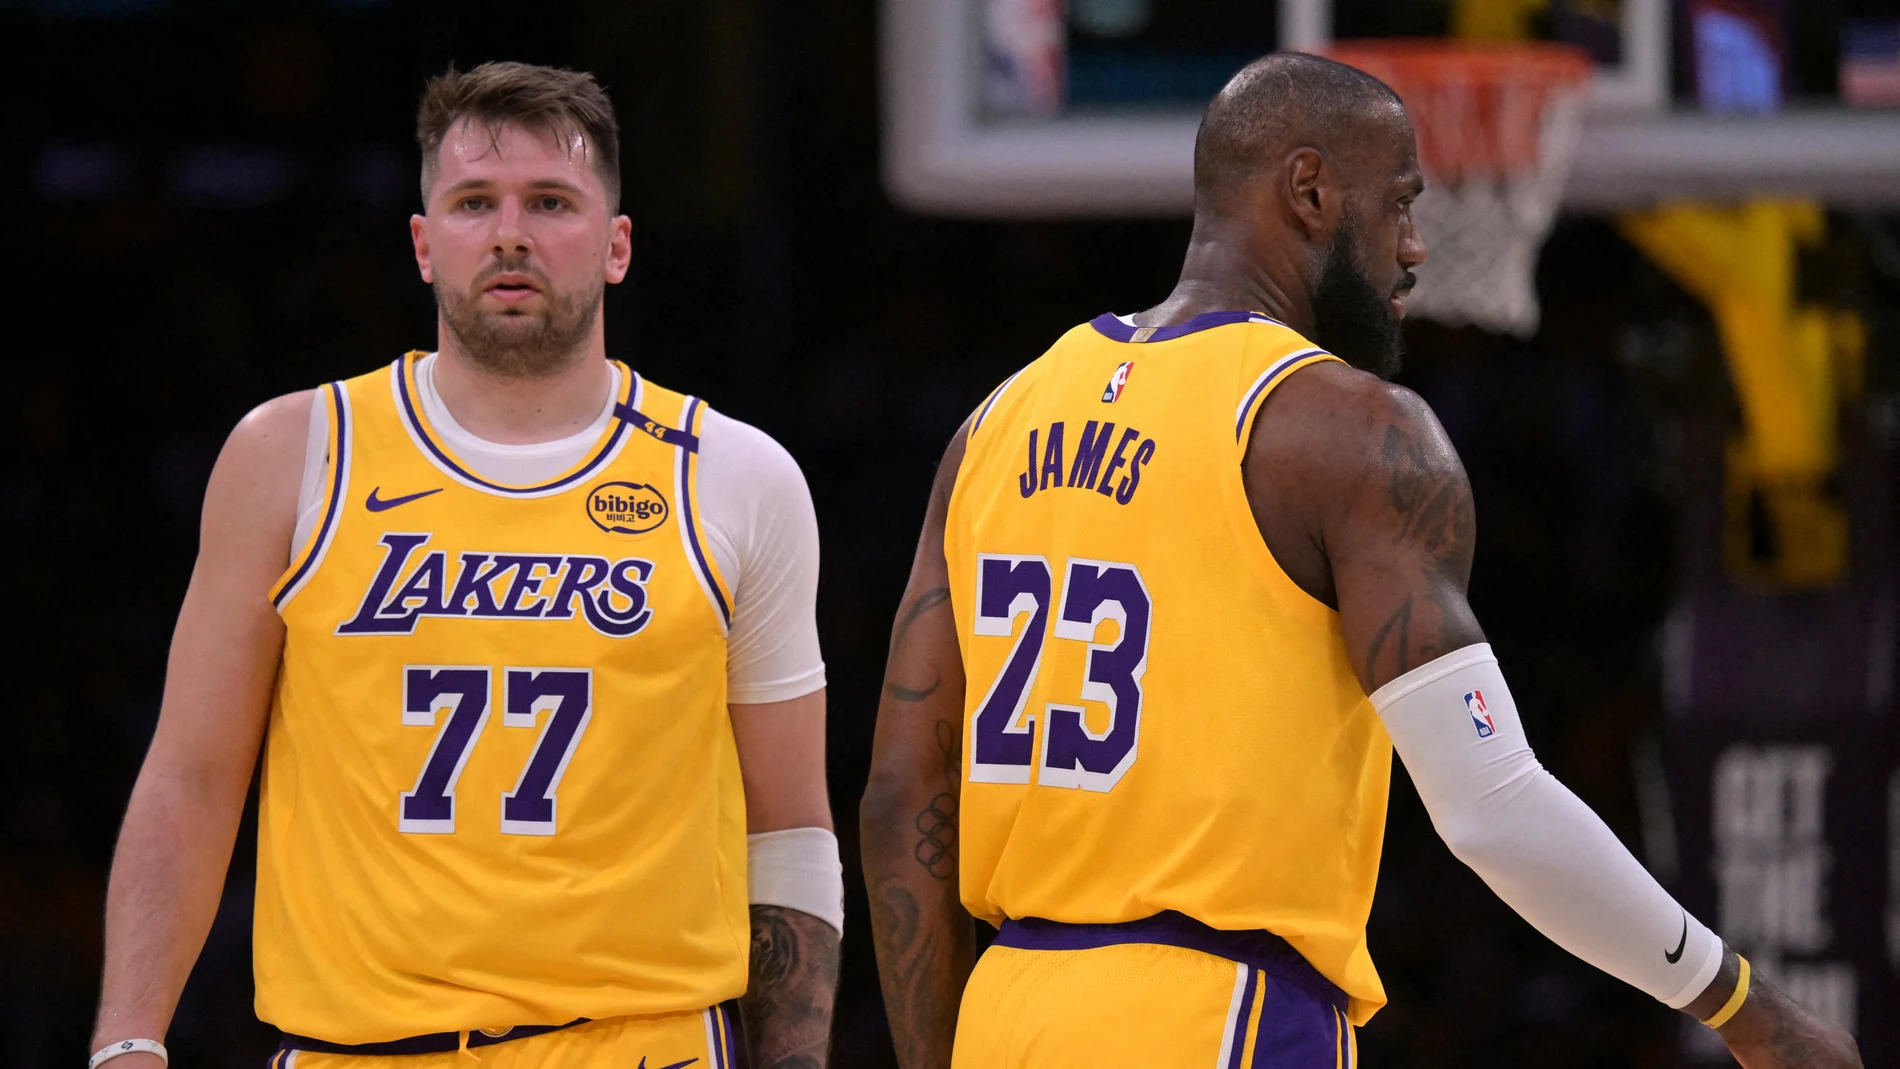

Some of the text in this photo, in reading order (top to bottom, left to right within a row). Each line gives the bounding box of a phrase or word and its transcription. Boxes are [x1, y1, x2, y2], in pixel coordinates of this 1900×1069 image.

[644, 422, 667, 438] 44
[1019, 420, 1156, 506] JAMES
[594, 494, 663, 519] bibigo
[606, 513, 635, 522] 비비고
[333, 531, 656, 639] LAKERS
[968, 552, 1153, 794] 23
[398, 664, 593, 836] 77
